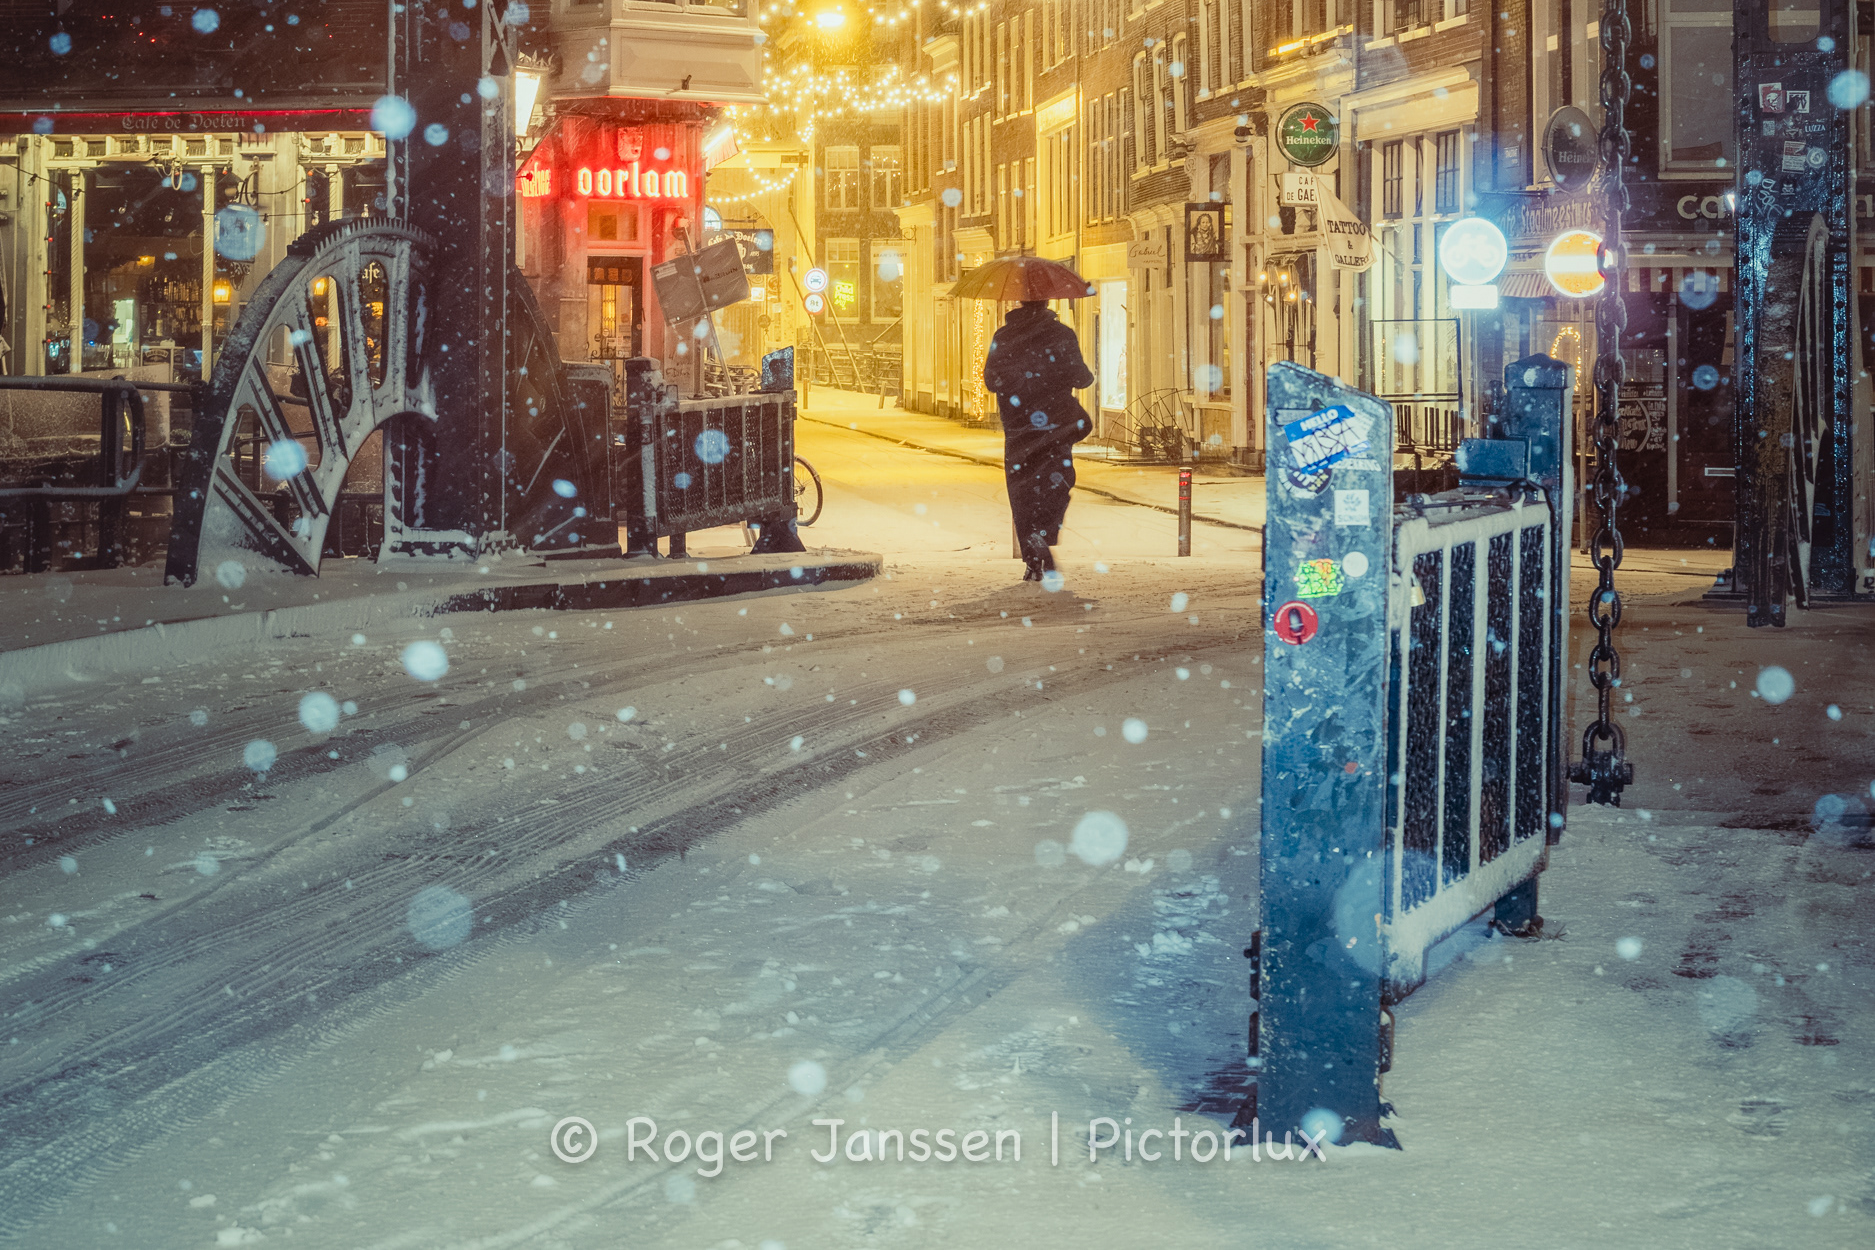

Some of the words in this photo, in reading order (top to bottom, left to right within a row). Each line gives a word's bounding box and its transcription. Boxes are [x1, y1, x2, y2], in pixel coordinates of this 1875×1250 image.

[165, 117, 181, 130] de
[1286, 135, 1332, 146] Heineken
[577, 161, 689, 198] oorlam
[1299, 177, 1317, 185] CAF
[1286, 192, 1295, 201] DE
[1297, 188, 1317, 202] GAE
[1327, 220, 1366, 235] TATTOO
[1129, 243, 1166, 258] Gabriel
[1347, 239, 1354, 250] &
[1300, 409, 1339, 431] HELLO
